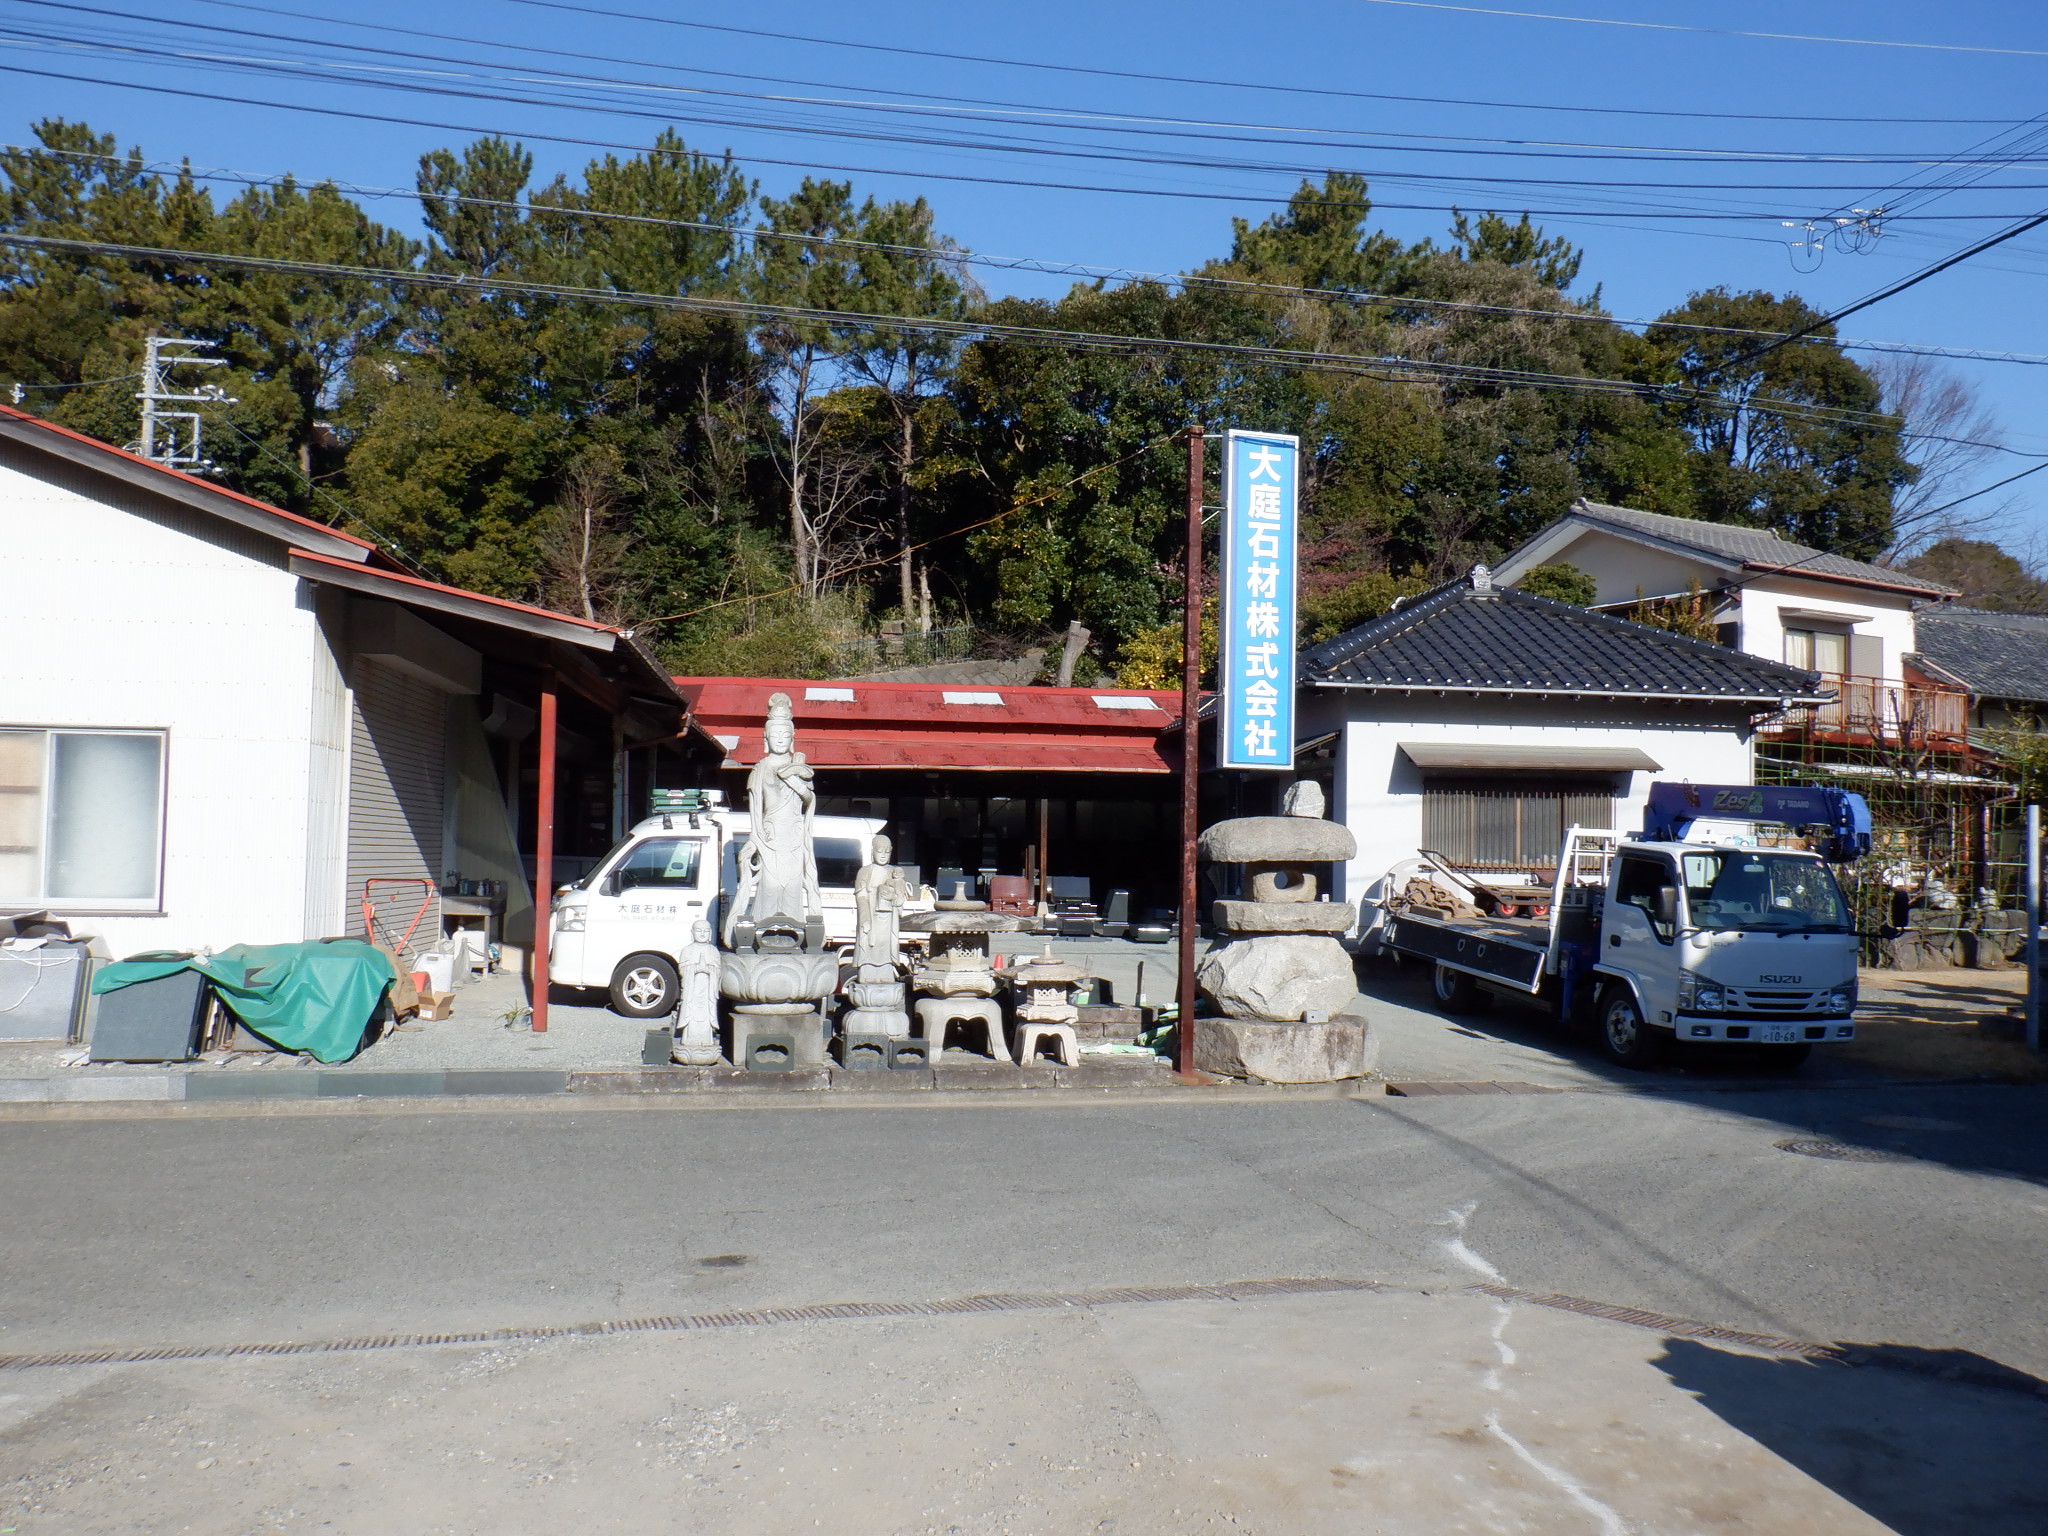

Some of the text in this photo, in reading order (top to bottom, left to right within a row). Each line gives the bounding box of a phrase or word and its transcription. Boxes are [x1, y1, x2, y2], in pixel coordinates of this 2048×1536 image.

[1243, 444, 1283, 758] 大庭石材株式会社
[1759, 974, 1802, 984] ISUZU
